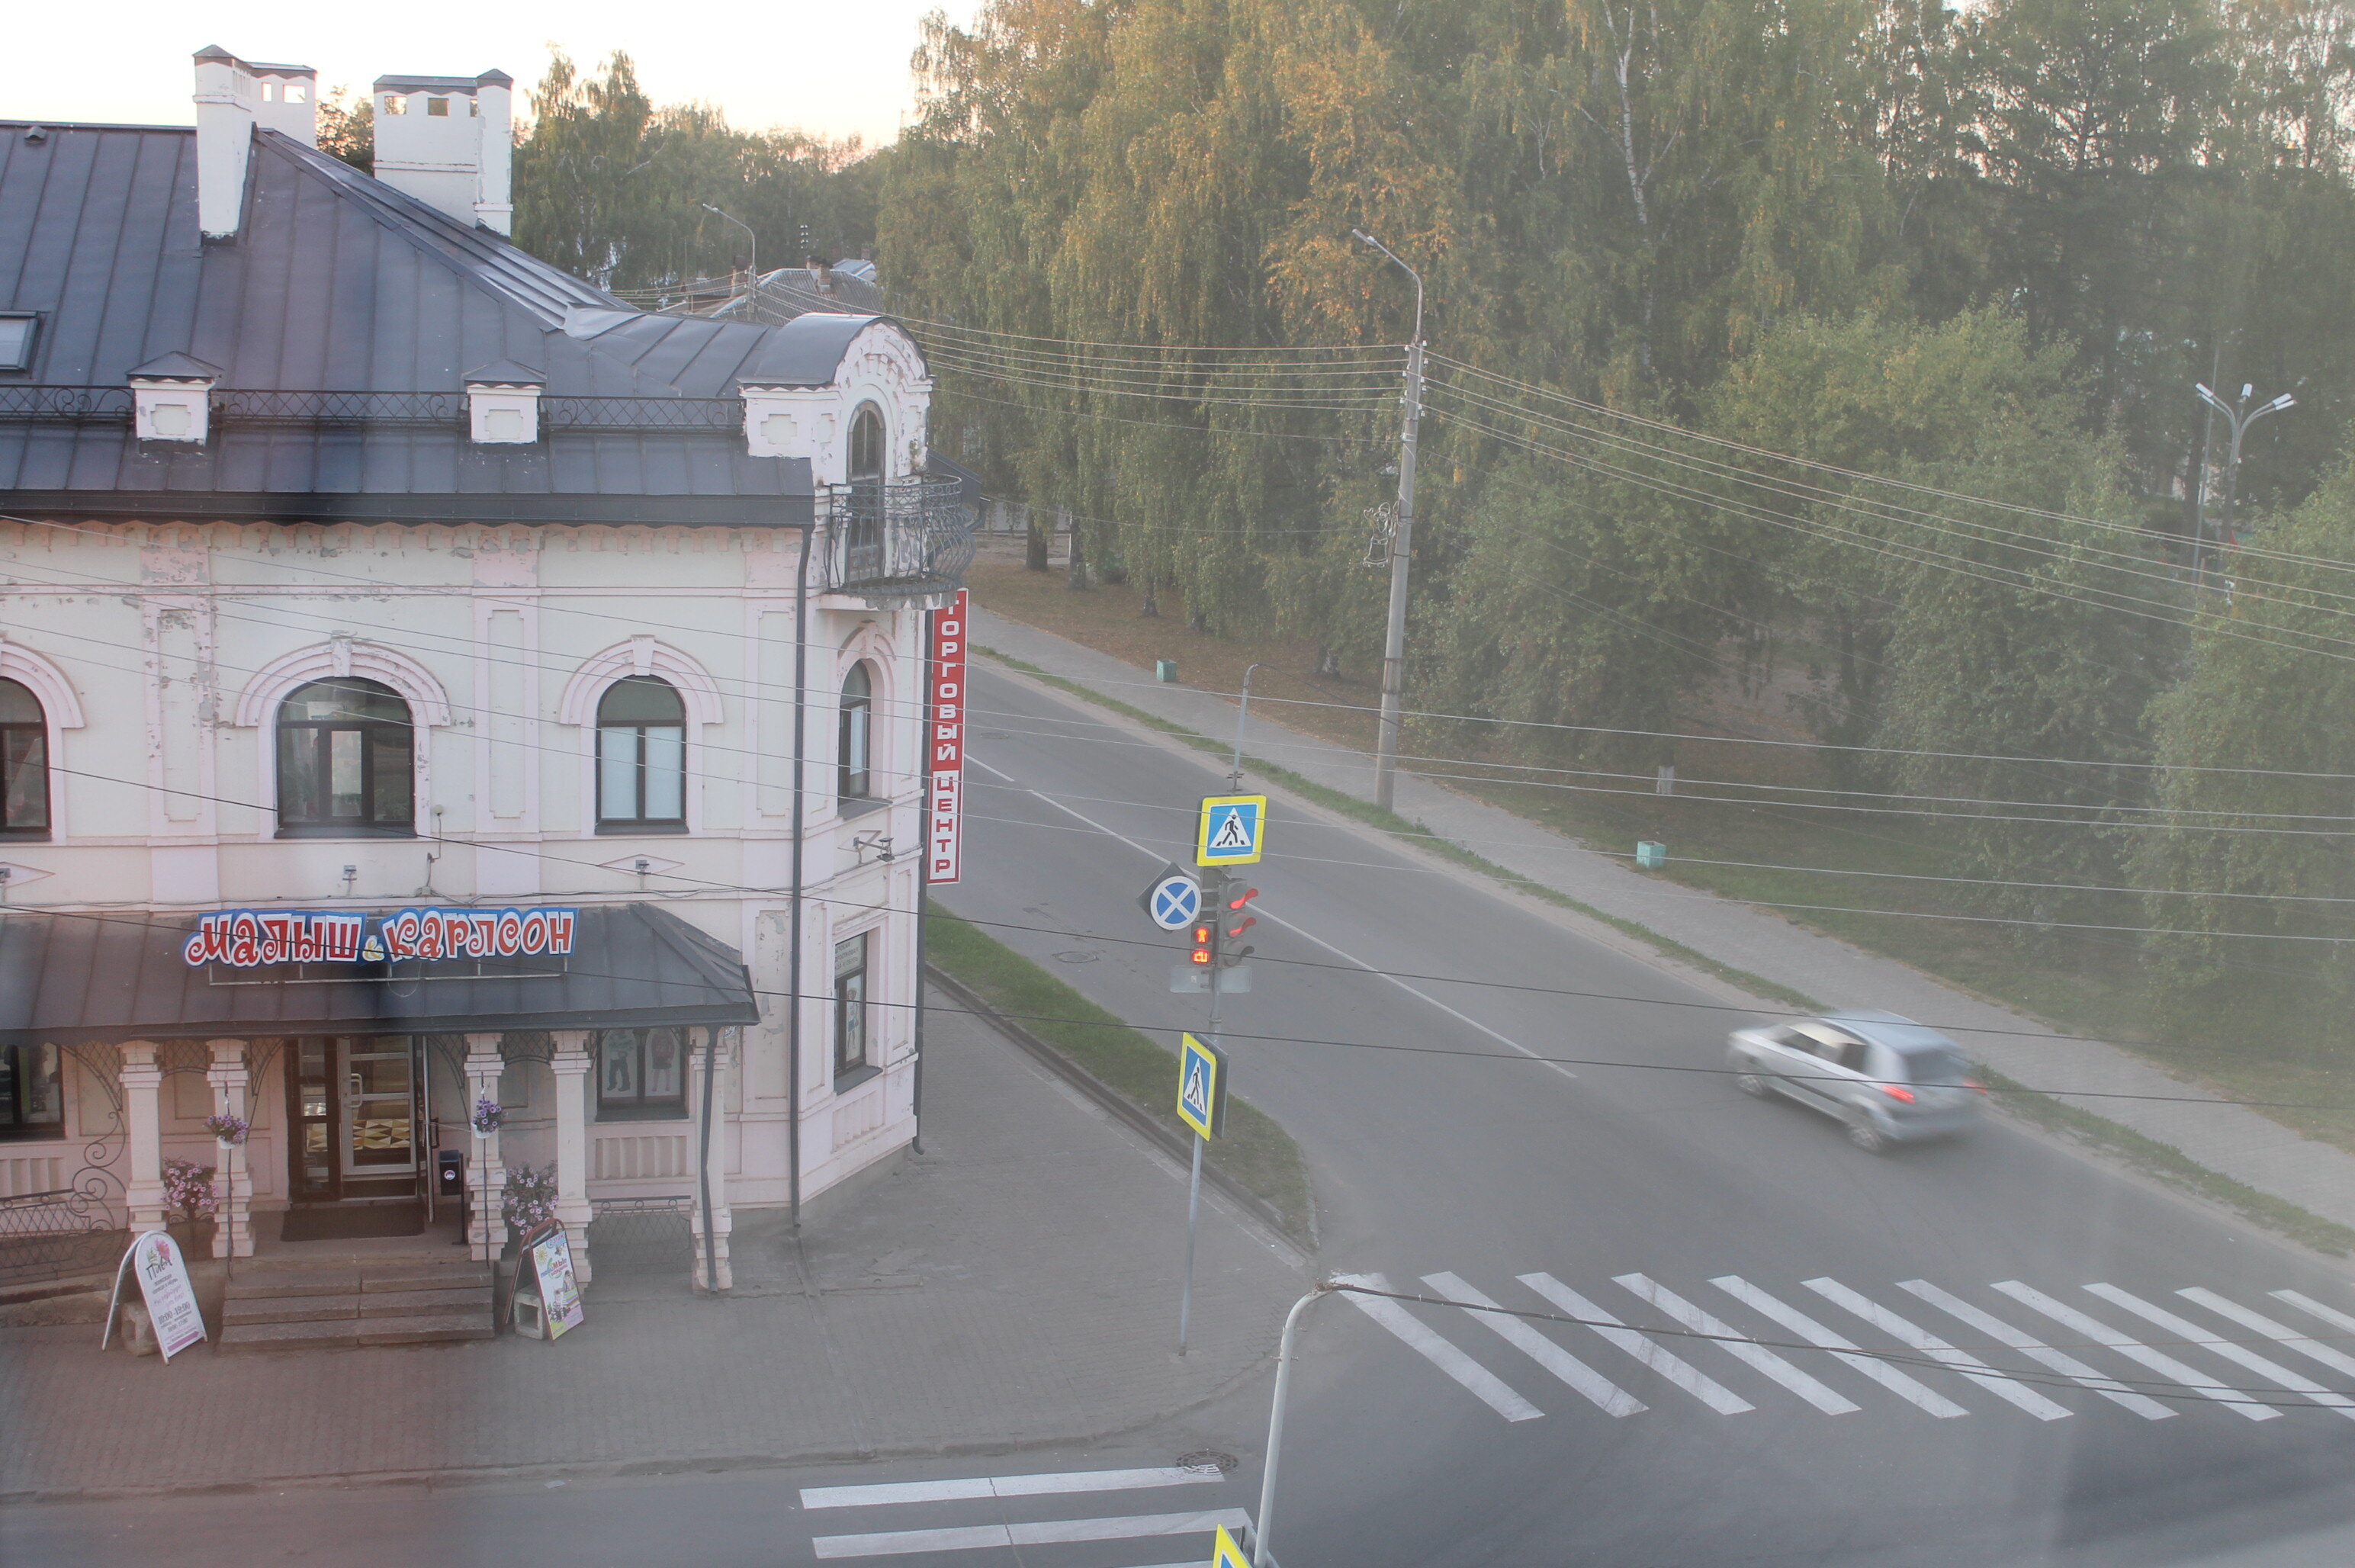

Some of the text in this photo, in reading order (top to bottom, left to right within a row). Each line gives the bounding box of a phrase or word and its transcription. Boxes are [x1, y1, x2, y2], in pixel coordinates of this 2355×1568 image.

[935, 776, 954, 873] ЦЕНТР
[362, 935, 385, 962] &
[174, 1301, 191, 1316] 19:00
